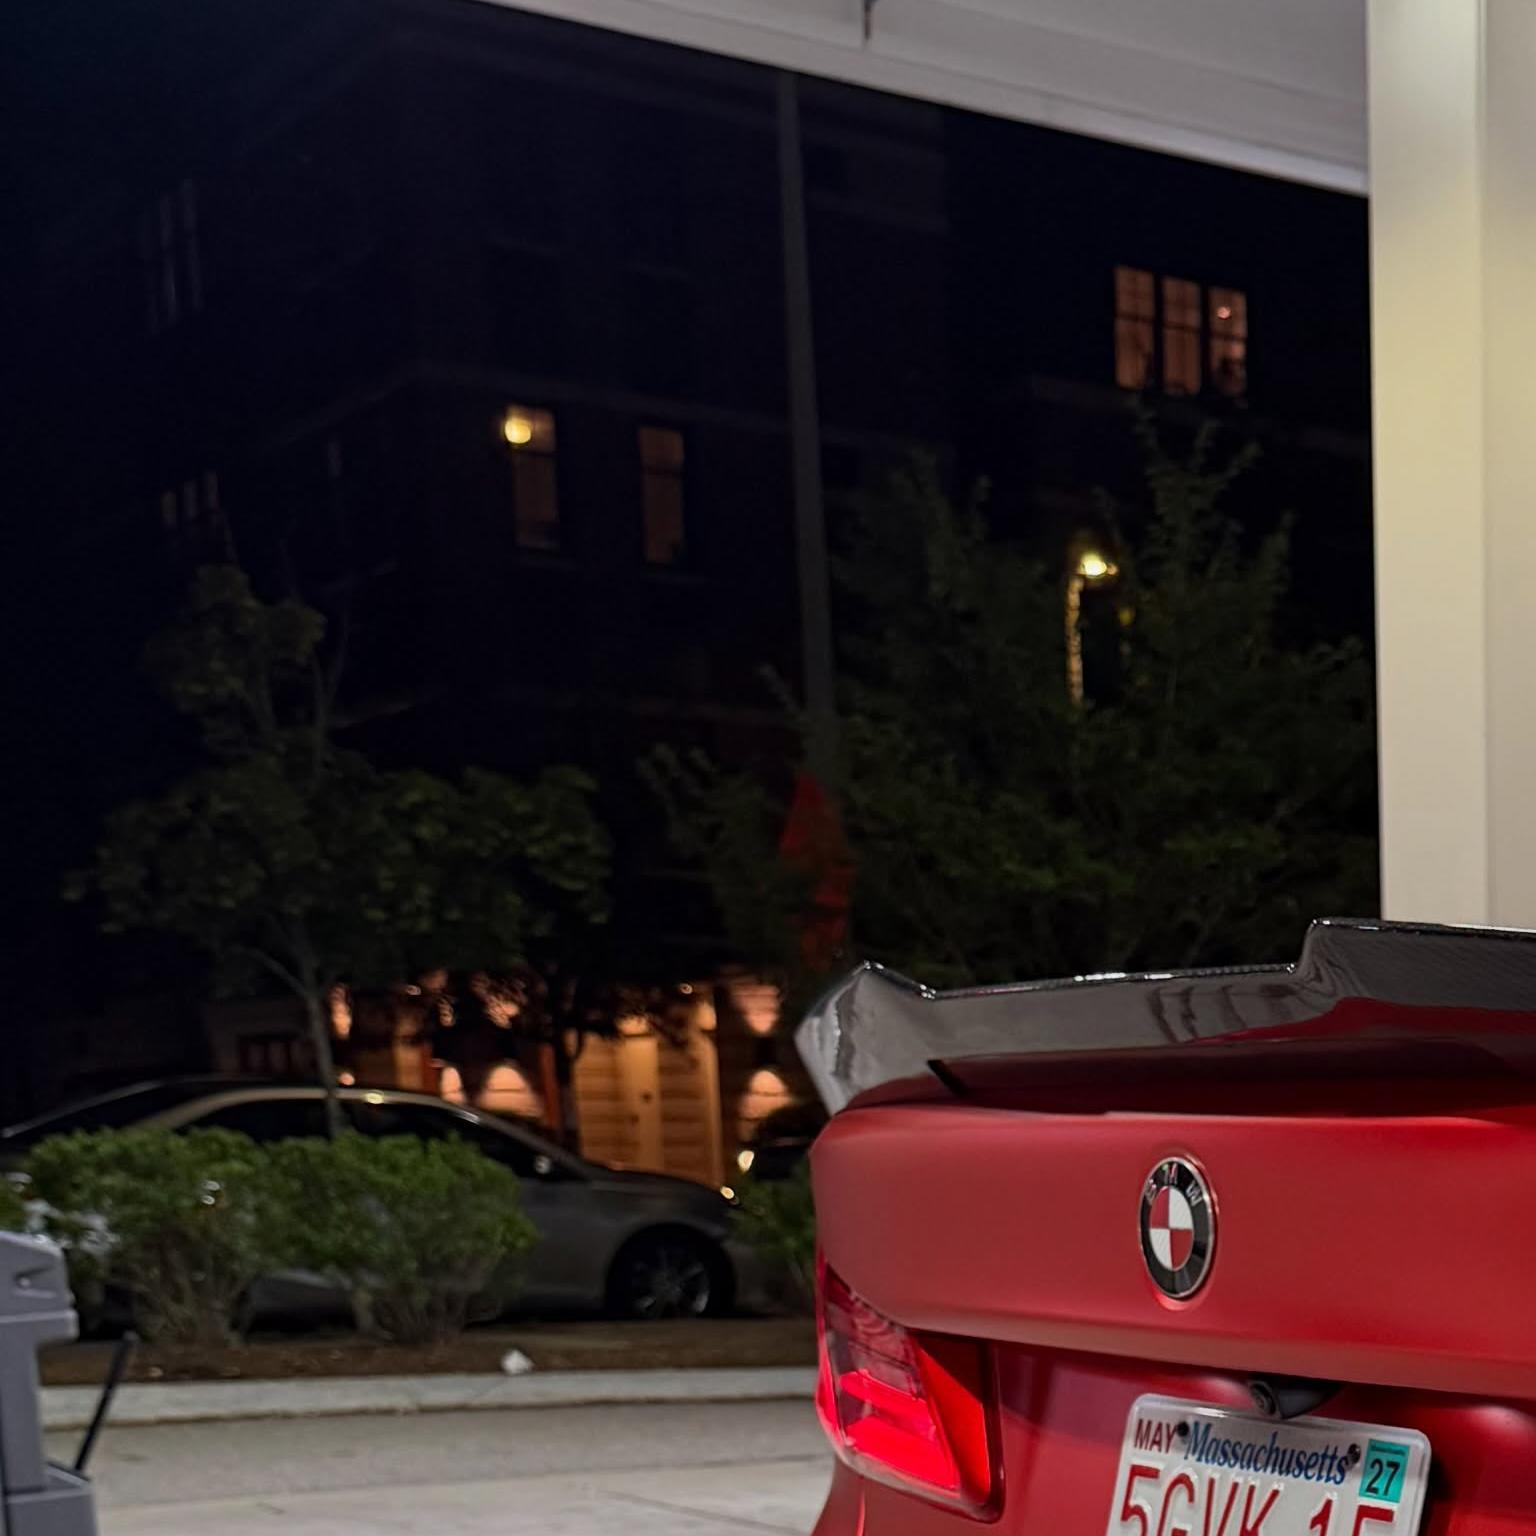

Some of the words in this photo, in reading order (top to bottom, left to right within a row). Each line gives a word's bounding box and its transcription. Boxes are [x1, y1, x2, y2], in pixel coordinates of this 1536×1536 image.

[1145, 1162, 1202, 1207] BMW
[1134, 1419, 1177, 1454] MAY
[1184, 1420, 1350, 1485] Massachusetts
[1365, 1458, 1401, 1497] 27
